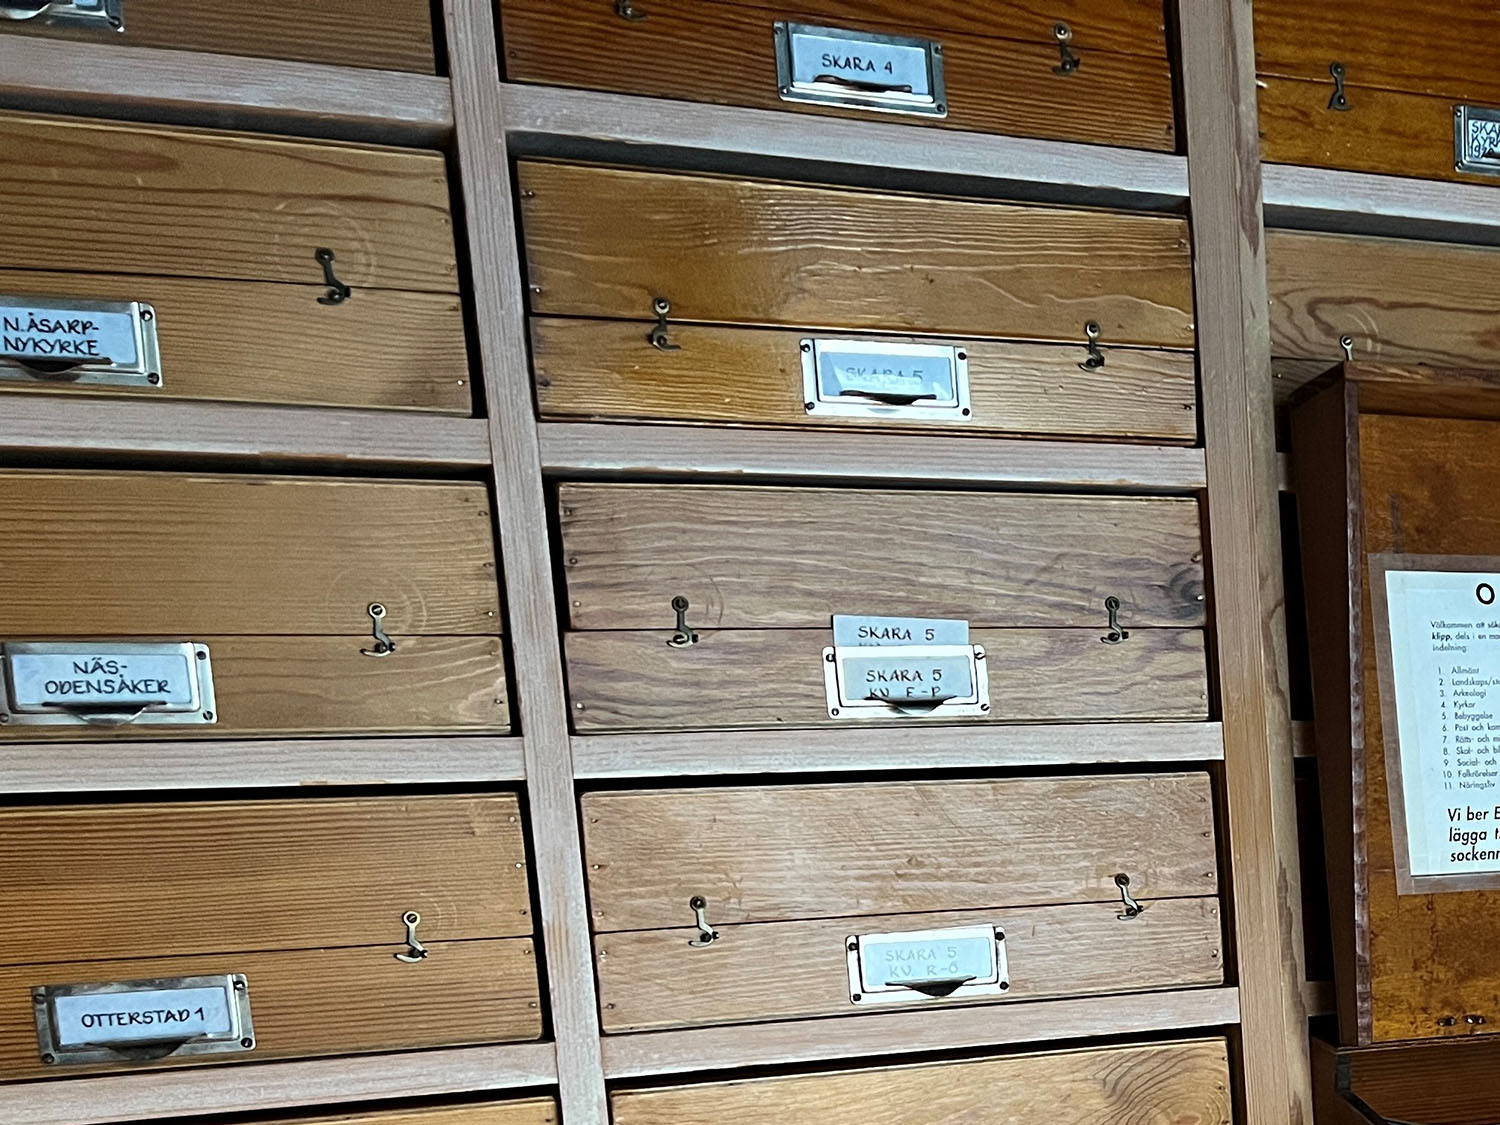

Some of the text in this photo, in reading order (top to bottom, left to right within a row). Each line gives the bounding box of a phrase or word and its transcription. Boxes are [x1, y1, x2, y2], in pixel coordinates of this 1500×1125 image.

[822, 54, 893, 75] SKARA 4
[3, 338, 100, 356] NYKYRKE
[857, 626, 935, 642] SKARA 5
[1455, 632, 1470, 640] dels
[72, 657, 128, 675] NÄS-
[866, 668, 943, 683] SKARA 5
[44, 675, 171, 696] ODENSÅKER
[1471, 723, 1485, 731] och
[1477, 734, 1490, 743] och
[1477, 745, 1490, 754] och
[1484, 757, 1497, 766] och
[1448, 808, 1461, 822] Vi
[1467, 805, 1489, 821] ber
[1449, 827, 1487, 846] lägga
[885, 946, 957, 962] SKARA 5
[81, 1007, 206, 1028] OTTERSTAD 1
